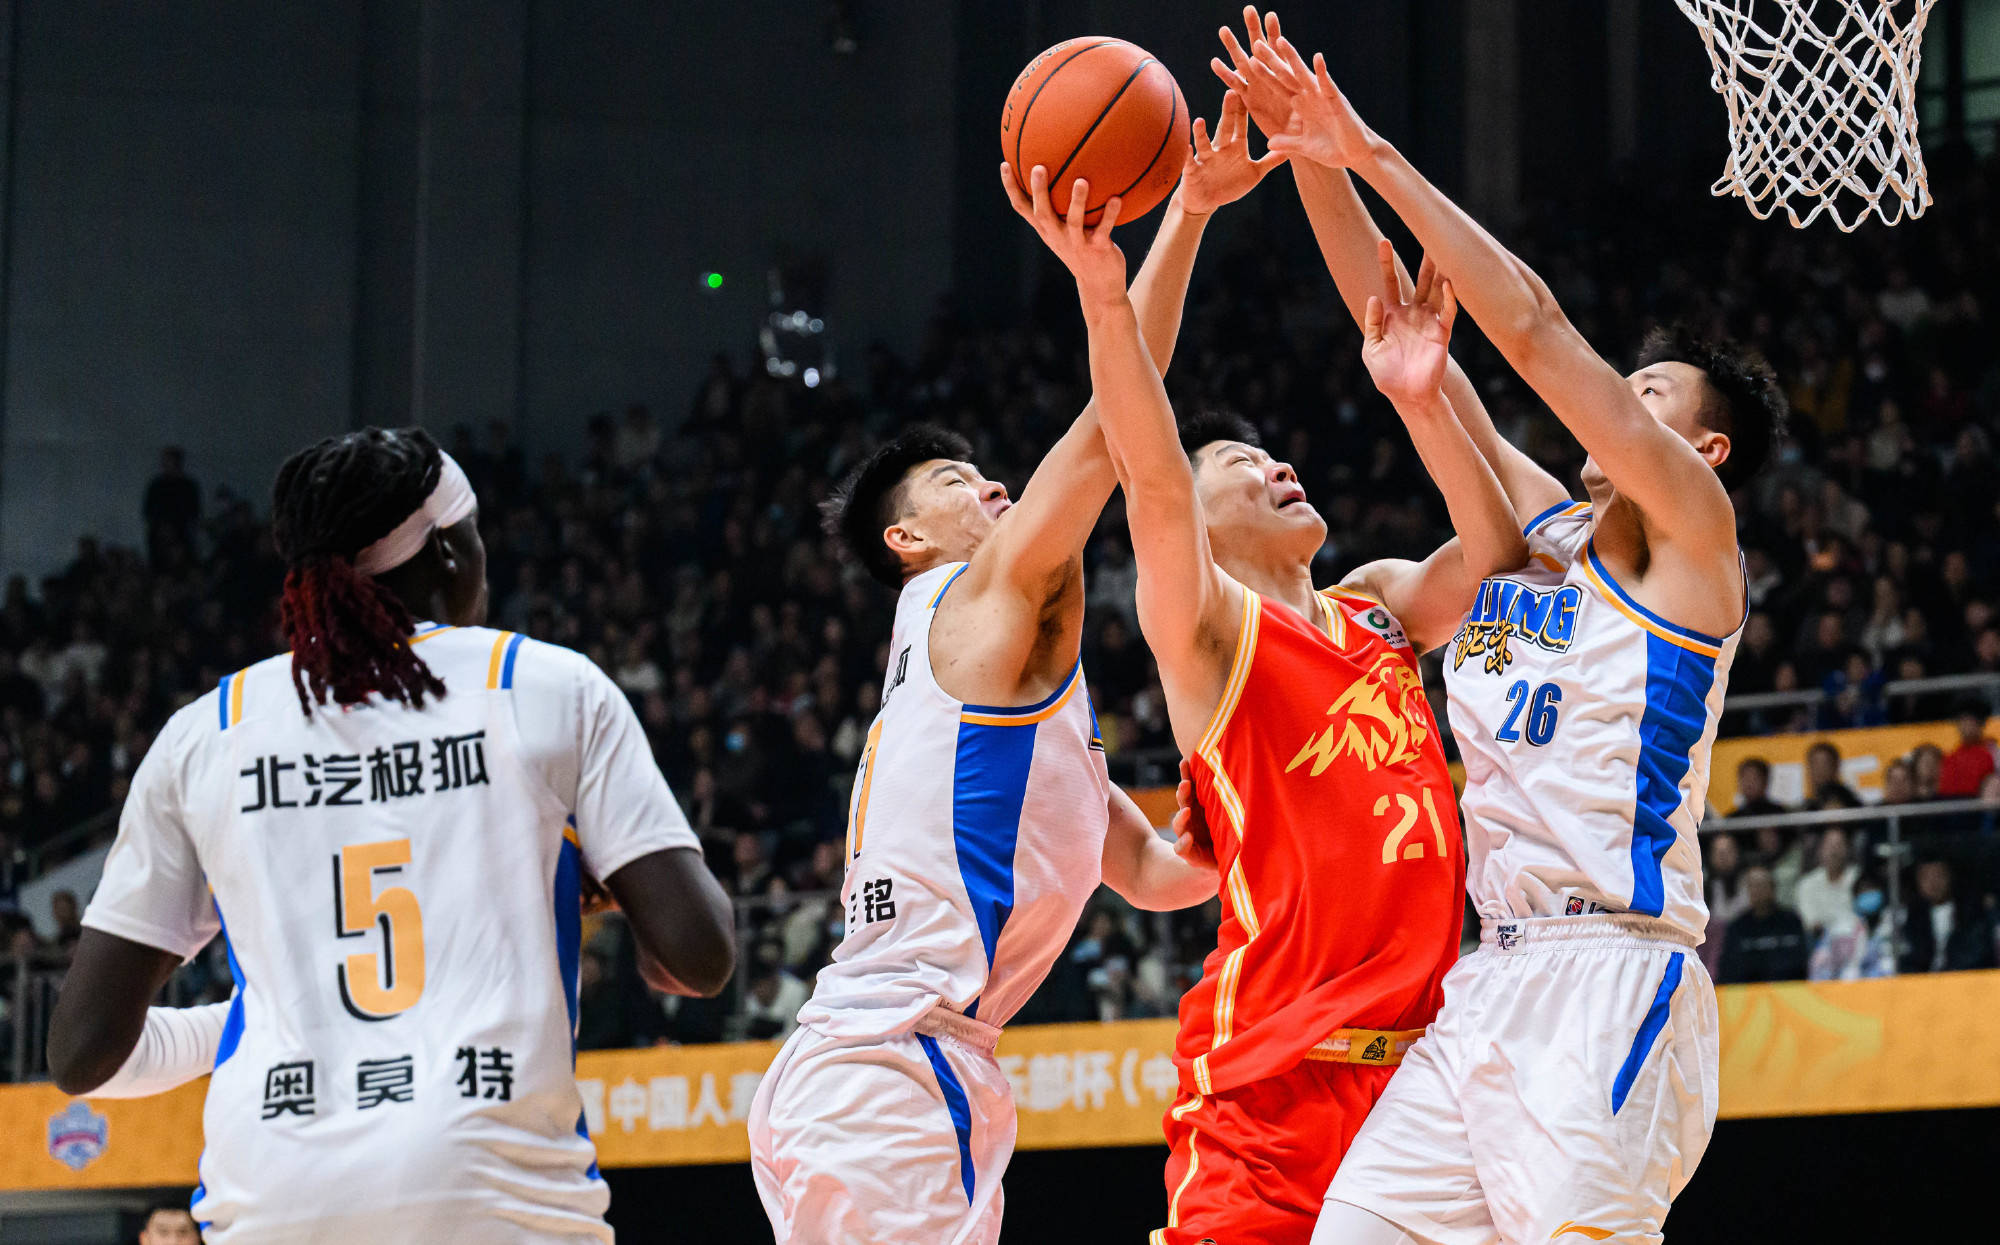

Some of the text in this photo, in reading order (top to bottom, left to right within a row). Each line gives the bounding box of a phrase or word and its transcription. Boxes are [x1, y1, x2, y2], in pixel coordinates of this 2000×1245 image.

[1461, 578, 1582, 653] IJING
[1495, 679, 1563, 747] 26
[240, 730, 490, 813] 北汽极狐
[1373, 786, 1448, 864] 21
[332, 838, 426, 1022] 5
[261, 1046, 515, 1120] 奥莫特
